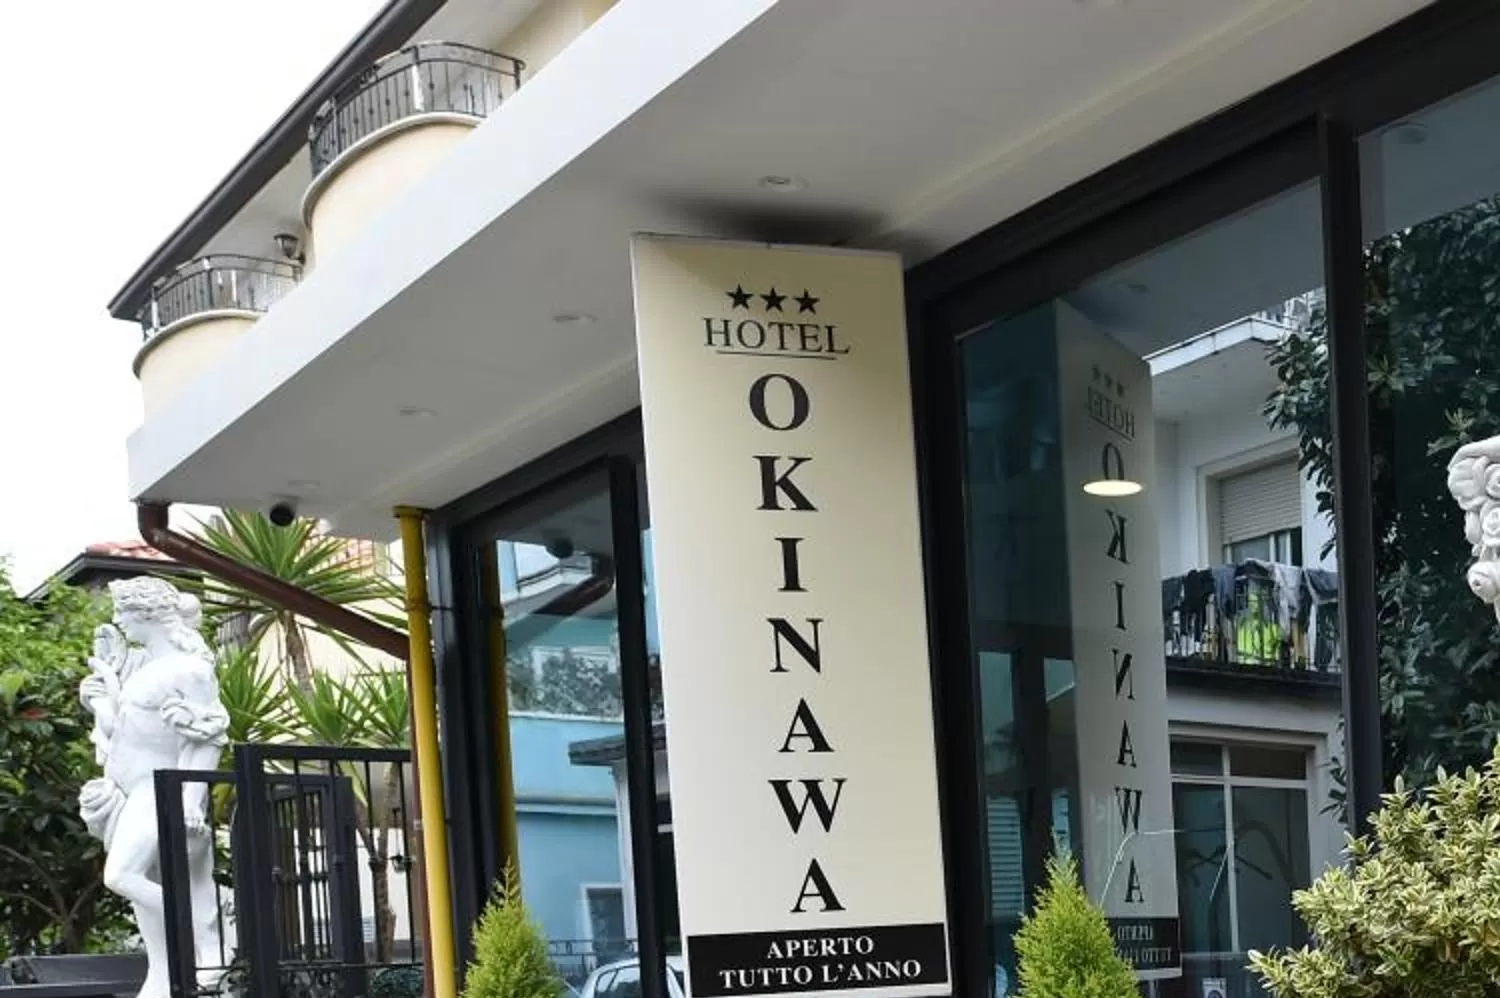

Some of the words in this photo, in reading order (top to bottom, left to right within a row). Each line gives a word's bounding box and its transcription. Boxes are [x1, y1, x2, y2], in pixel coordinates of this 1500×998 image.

[703, 317, 850, 354] HOTEL
[749, 373, 847, 913] OKINAWA
[767, 935, 874, 959] APERTO
[719, 965, 813, 988] TUTTO
[822, 959, 922, 983] L'ANNO
